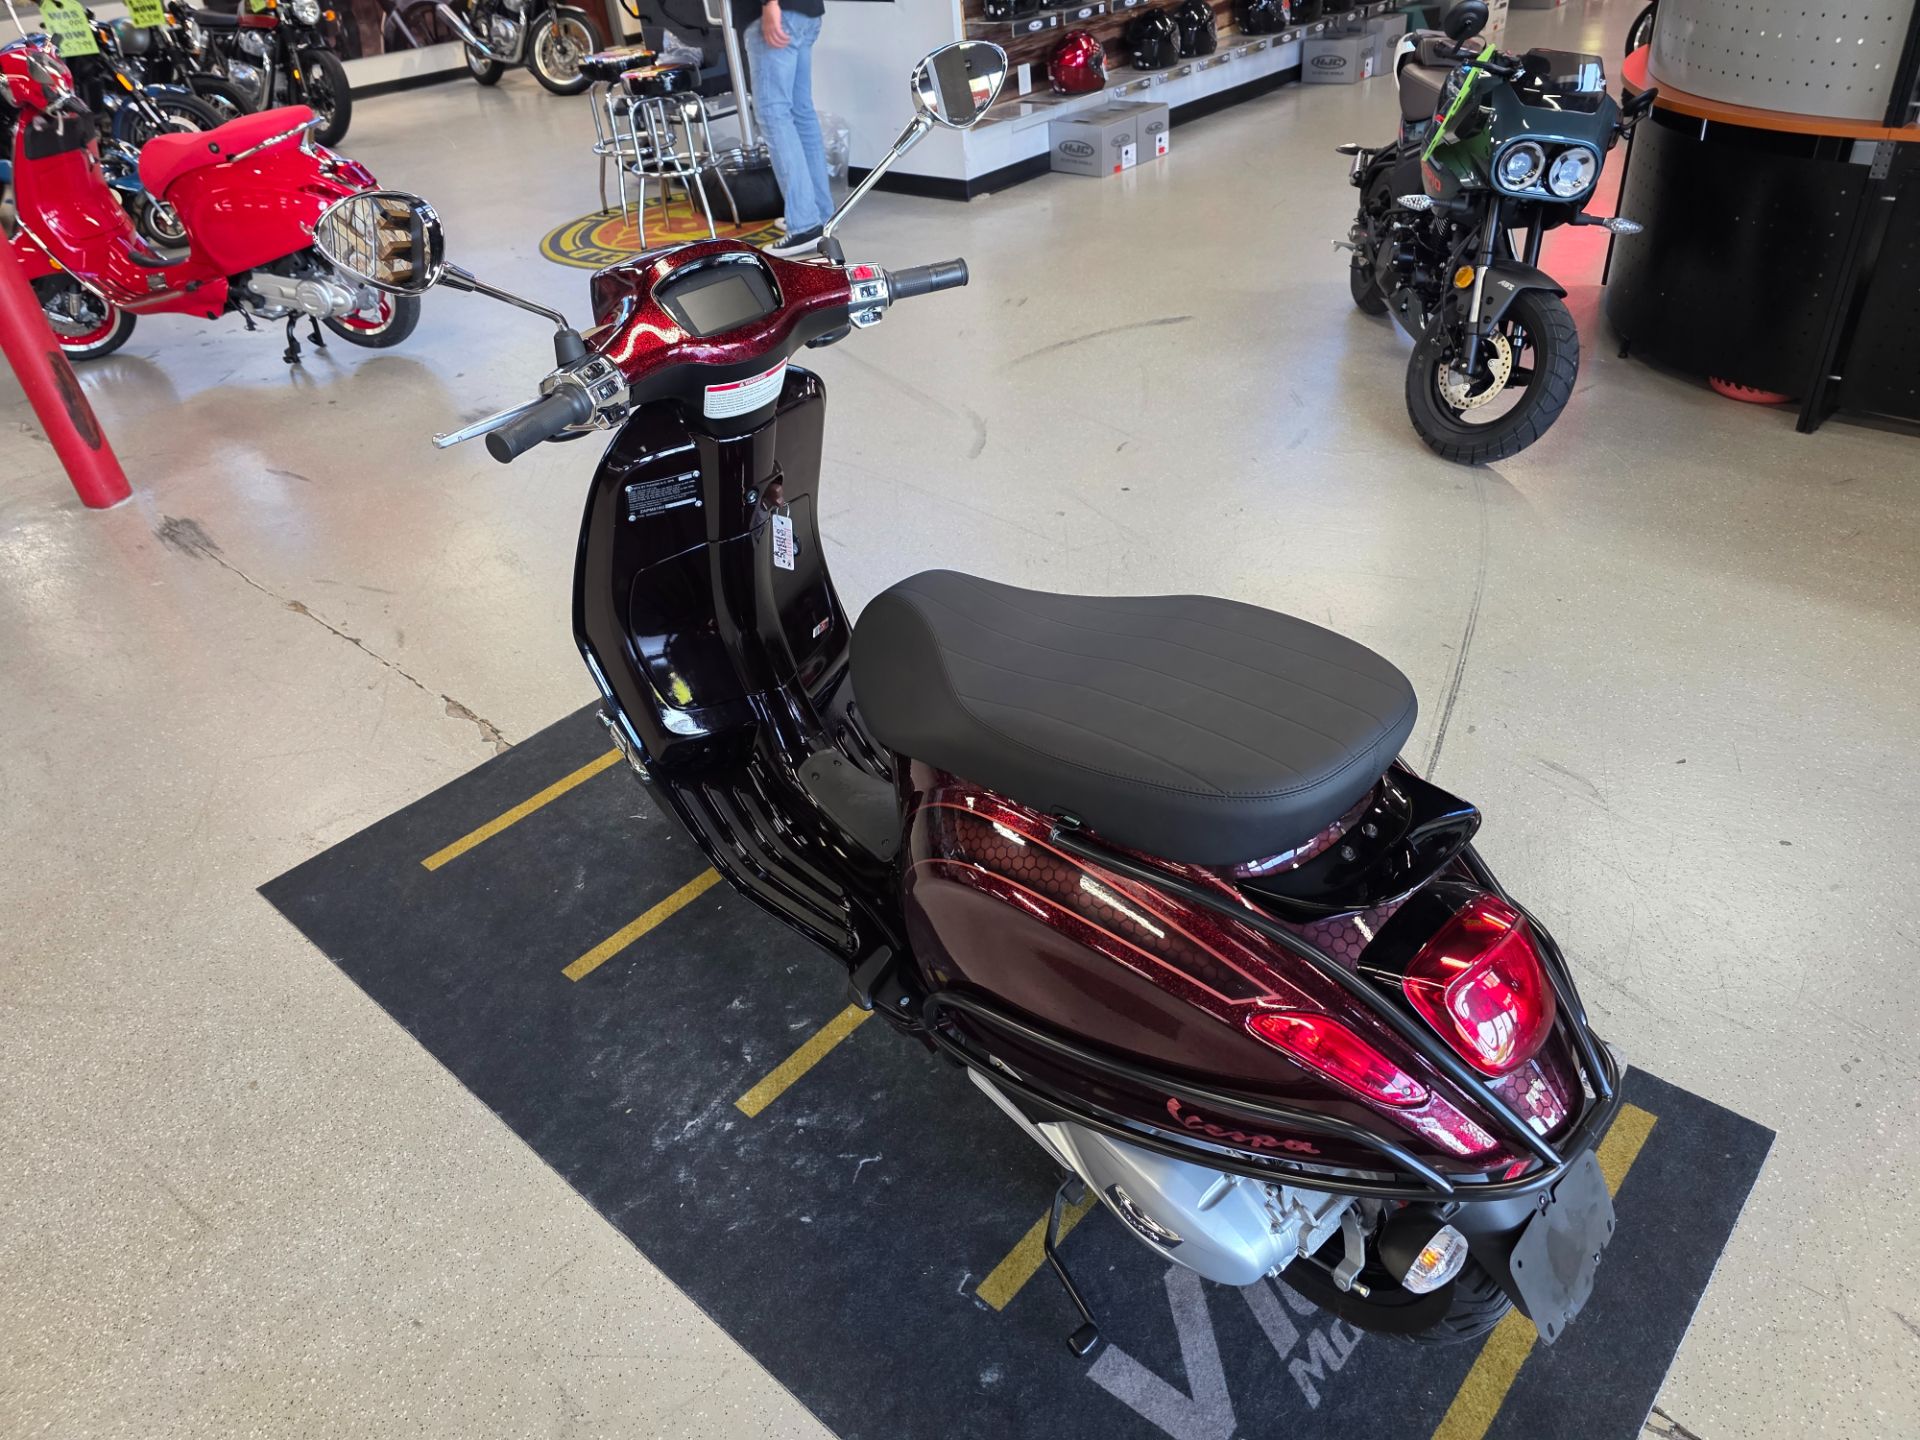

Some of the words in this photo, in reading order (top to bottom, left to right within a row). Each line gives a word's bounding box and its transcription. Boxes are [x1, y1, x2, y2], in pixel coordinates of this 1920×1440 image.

[48, 10, 79, 20] WAS
[1314, 57, 1344, 67] HJC
[1062, 142, 1091, 155] HJC
[1166, 1097, 1321, 1155] Vespa
